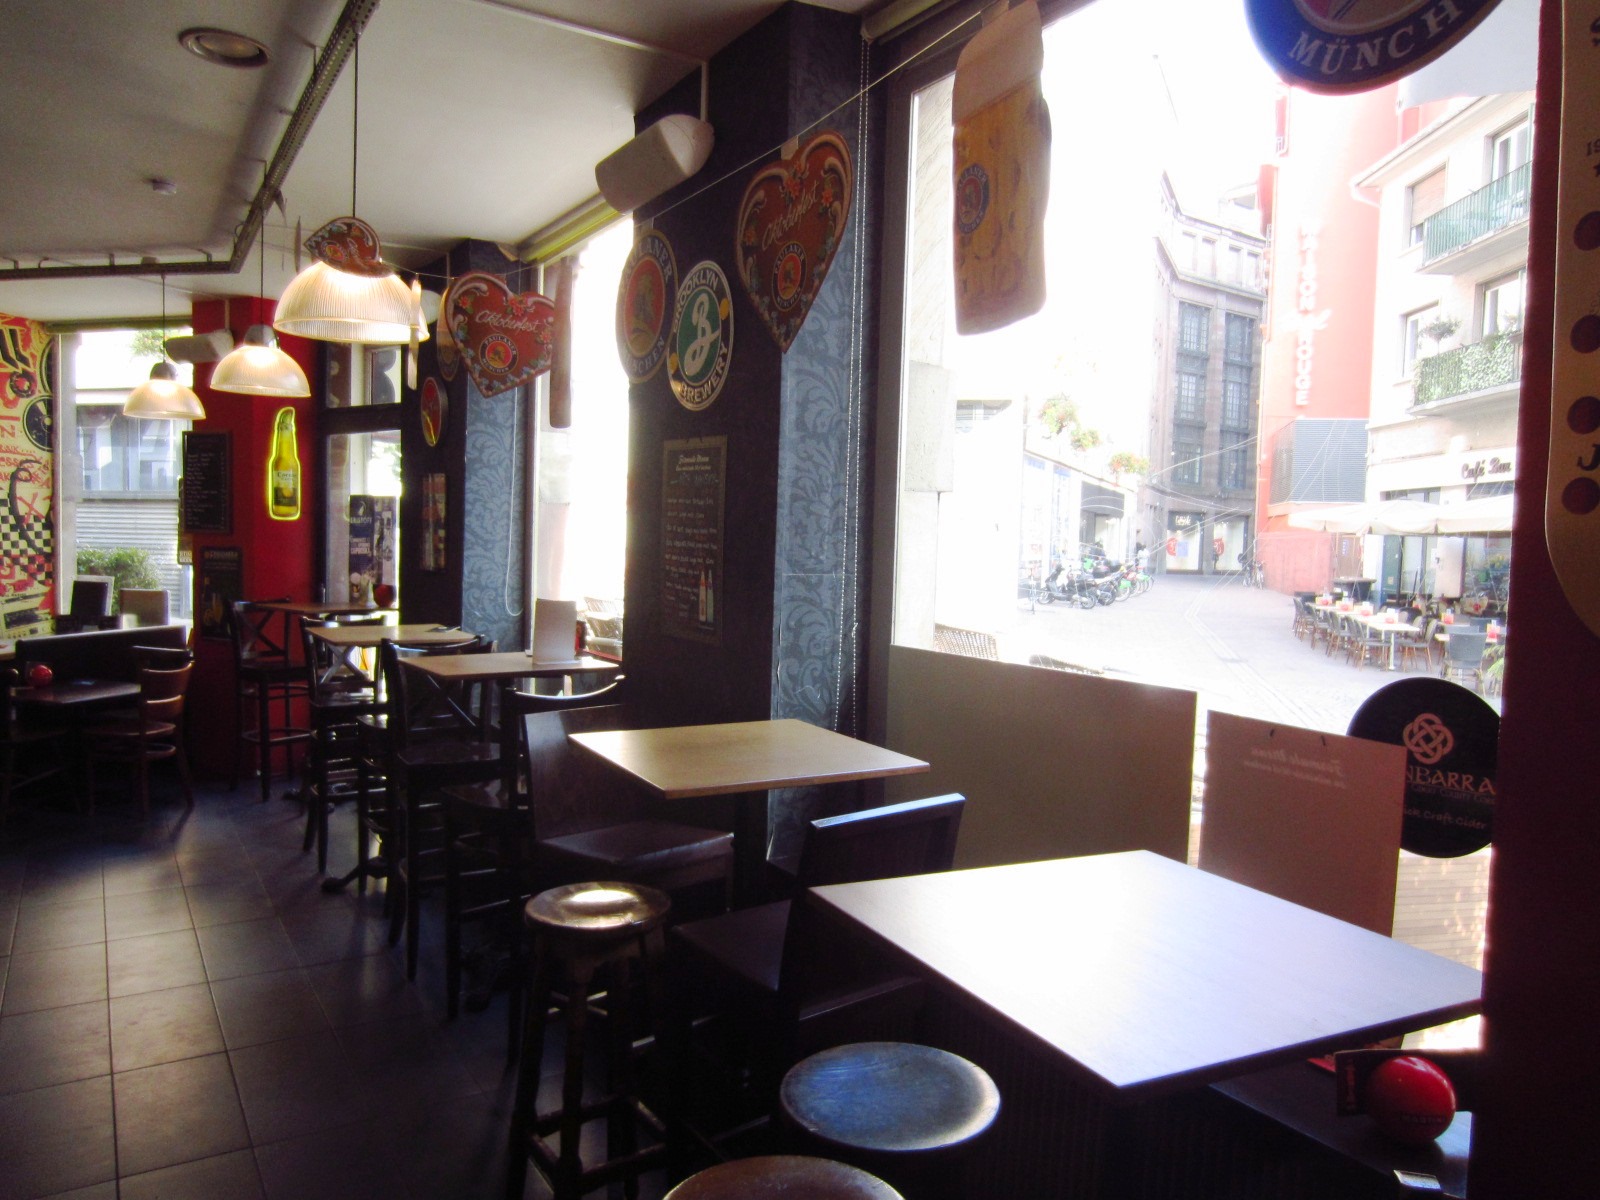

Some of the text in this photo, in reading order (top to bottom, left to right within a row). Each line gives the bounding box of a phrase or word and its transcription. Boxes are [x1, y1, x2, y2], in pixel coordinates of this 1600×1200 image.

[762, 180, 820, 250] Oktoberfest
[774, 244, 805, 275] PAULANER
[673, 269, 719, 333] BROOKLYN
[475, 309, 542, 336] Oktoberfest
[483, 335, 518, 356] PAULANER
[679, 341, 729, 403] BREWERY
[1461, 458, 1486, 483] Café
[1455, 816, 1487, 829] Cider
